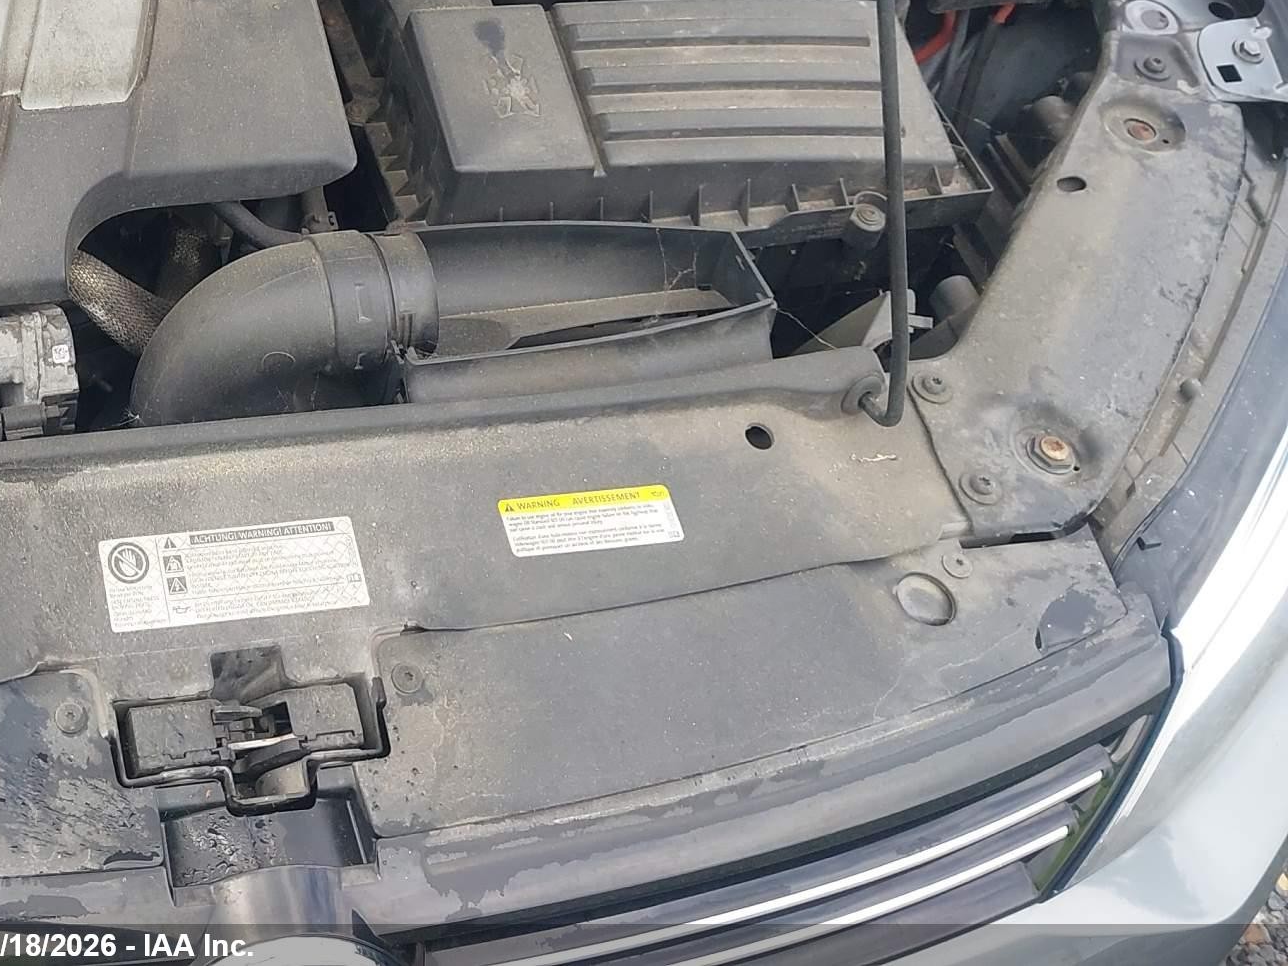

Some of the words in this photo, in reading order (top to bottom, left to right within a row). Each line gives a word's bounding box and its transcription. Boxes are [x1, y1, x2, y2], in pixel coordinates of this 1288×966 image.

[516, 500, 561, 511] WARNING
[572, 492, 641, 506] AVERTISSEMENT
[193, 533, 238, 544] ACHTUNG!
[239, 528, 282, 540] WARNING!
[284, 523, 333, 536] ATTENTION!
